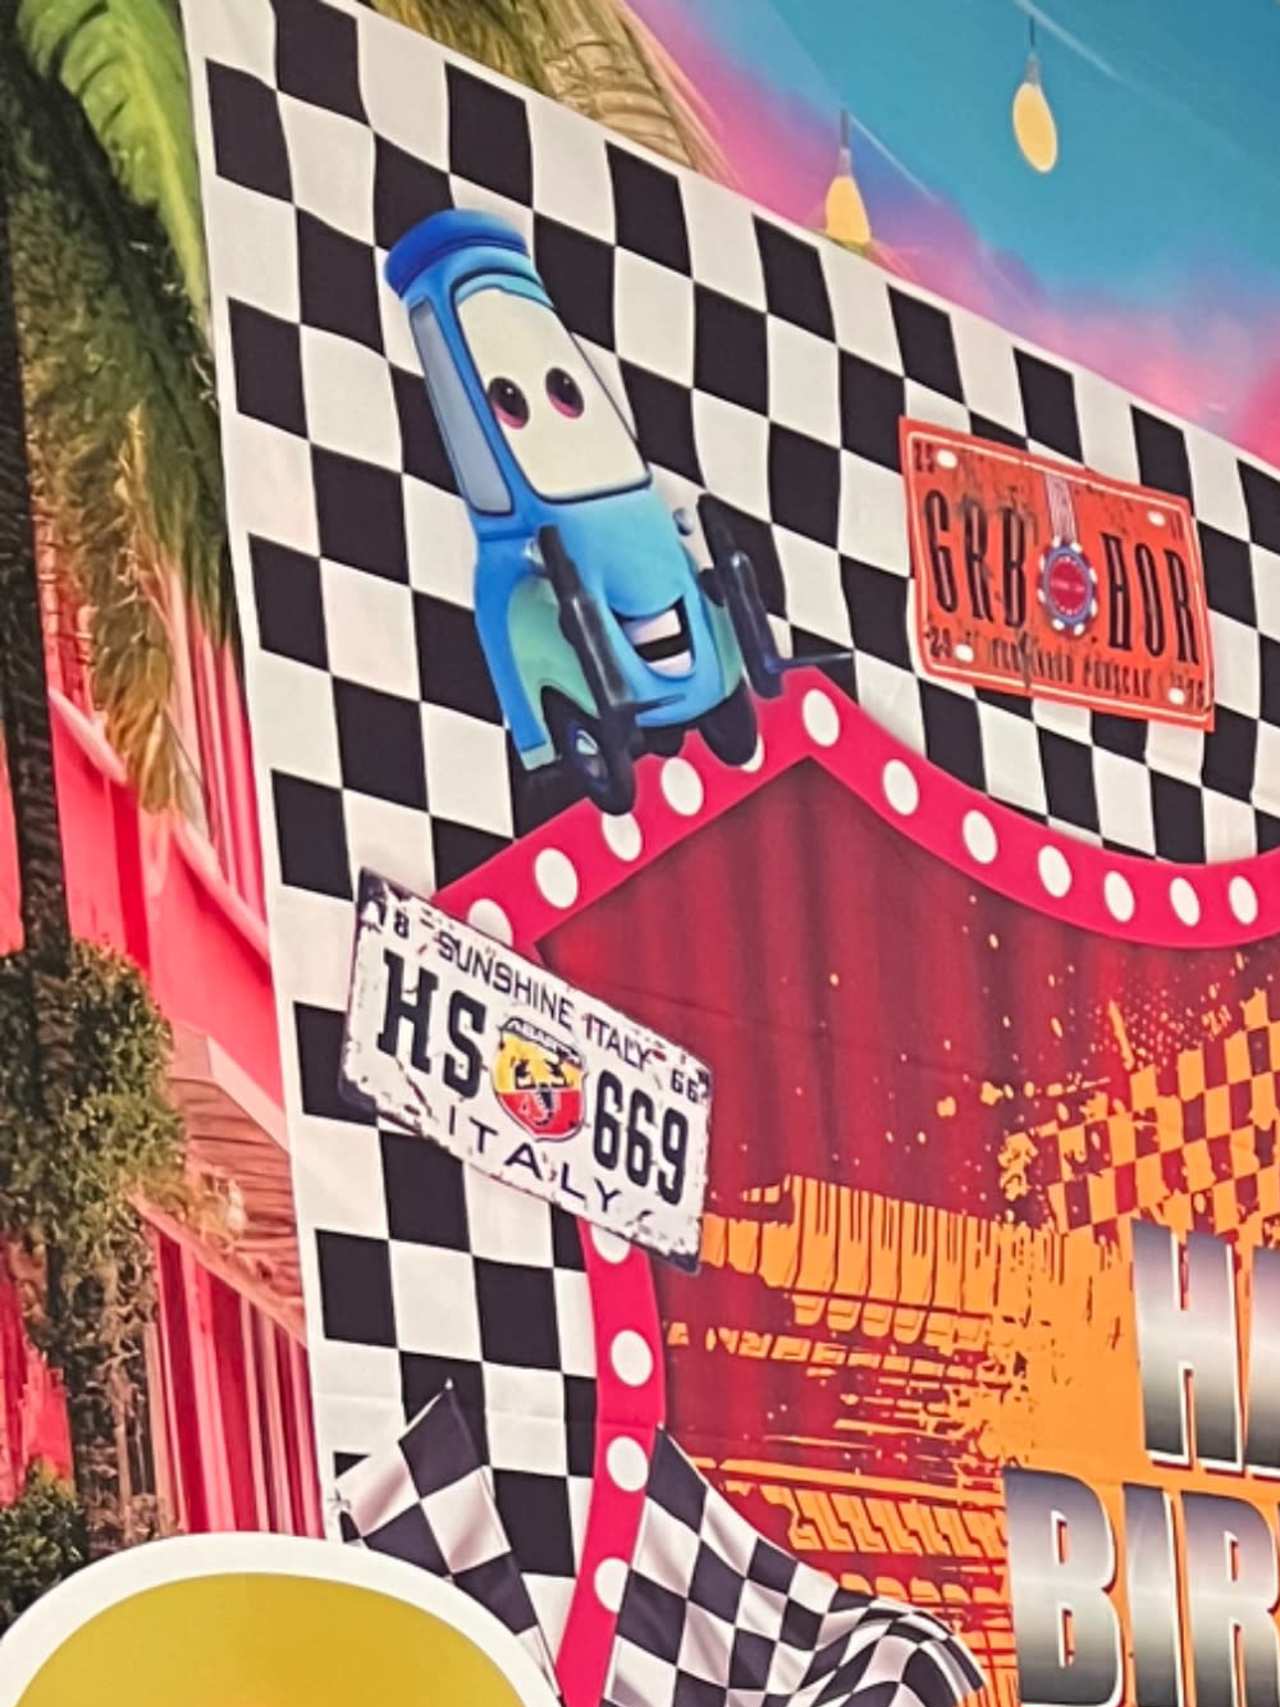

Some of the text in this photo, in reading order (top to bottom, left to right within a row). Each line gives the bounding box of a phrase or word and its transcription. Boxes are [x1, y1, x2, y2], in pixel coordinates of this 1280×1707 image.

[434, 928, 660, 1074] SUNSHINE ITALY
[375, 947, 690, 1208] HS 669
[447, 1104, 624, 1217] ITALY
